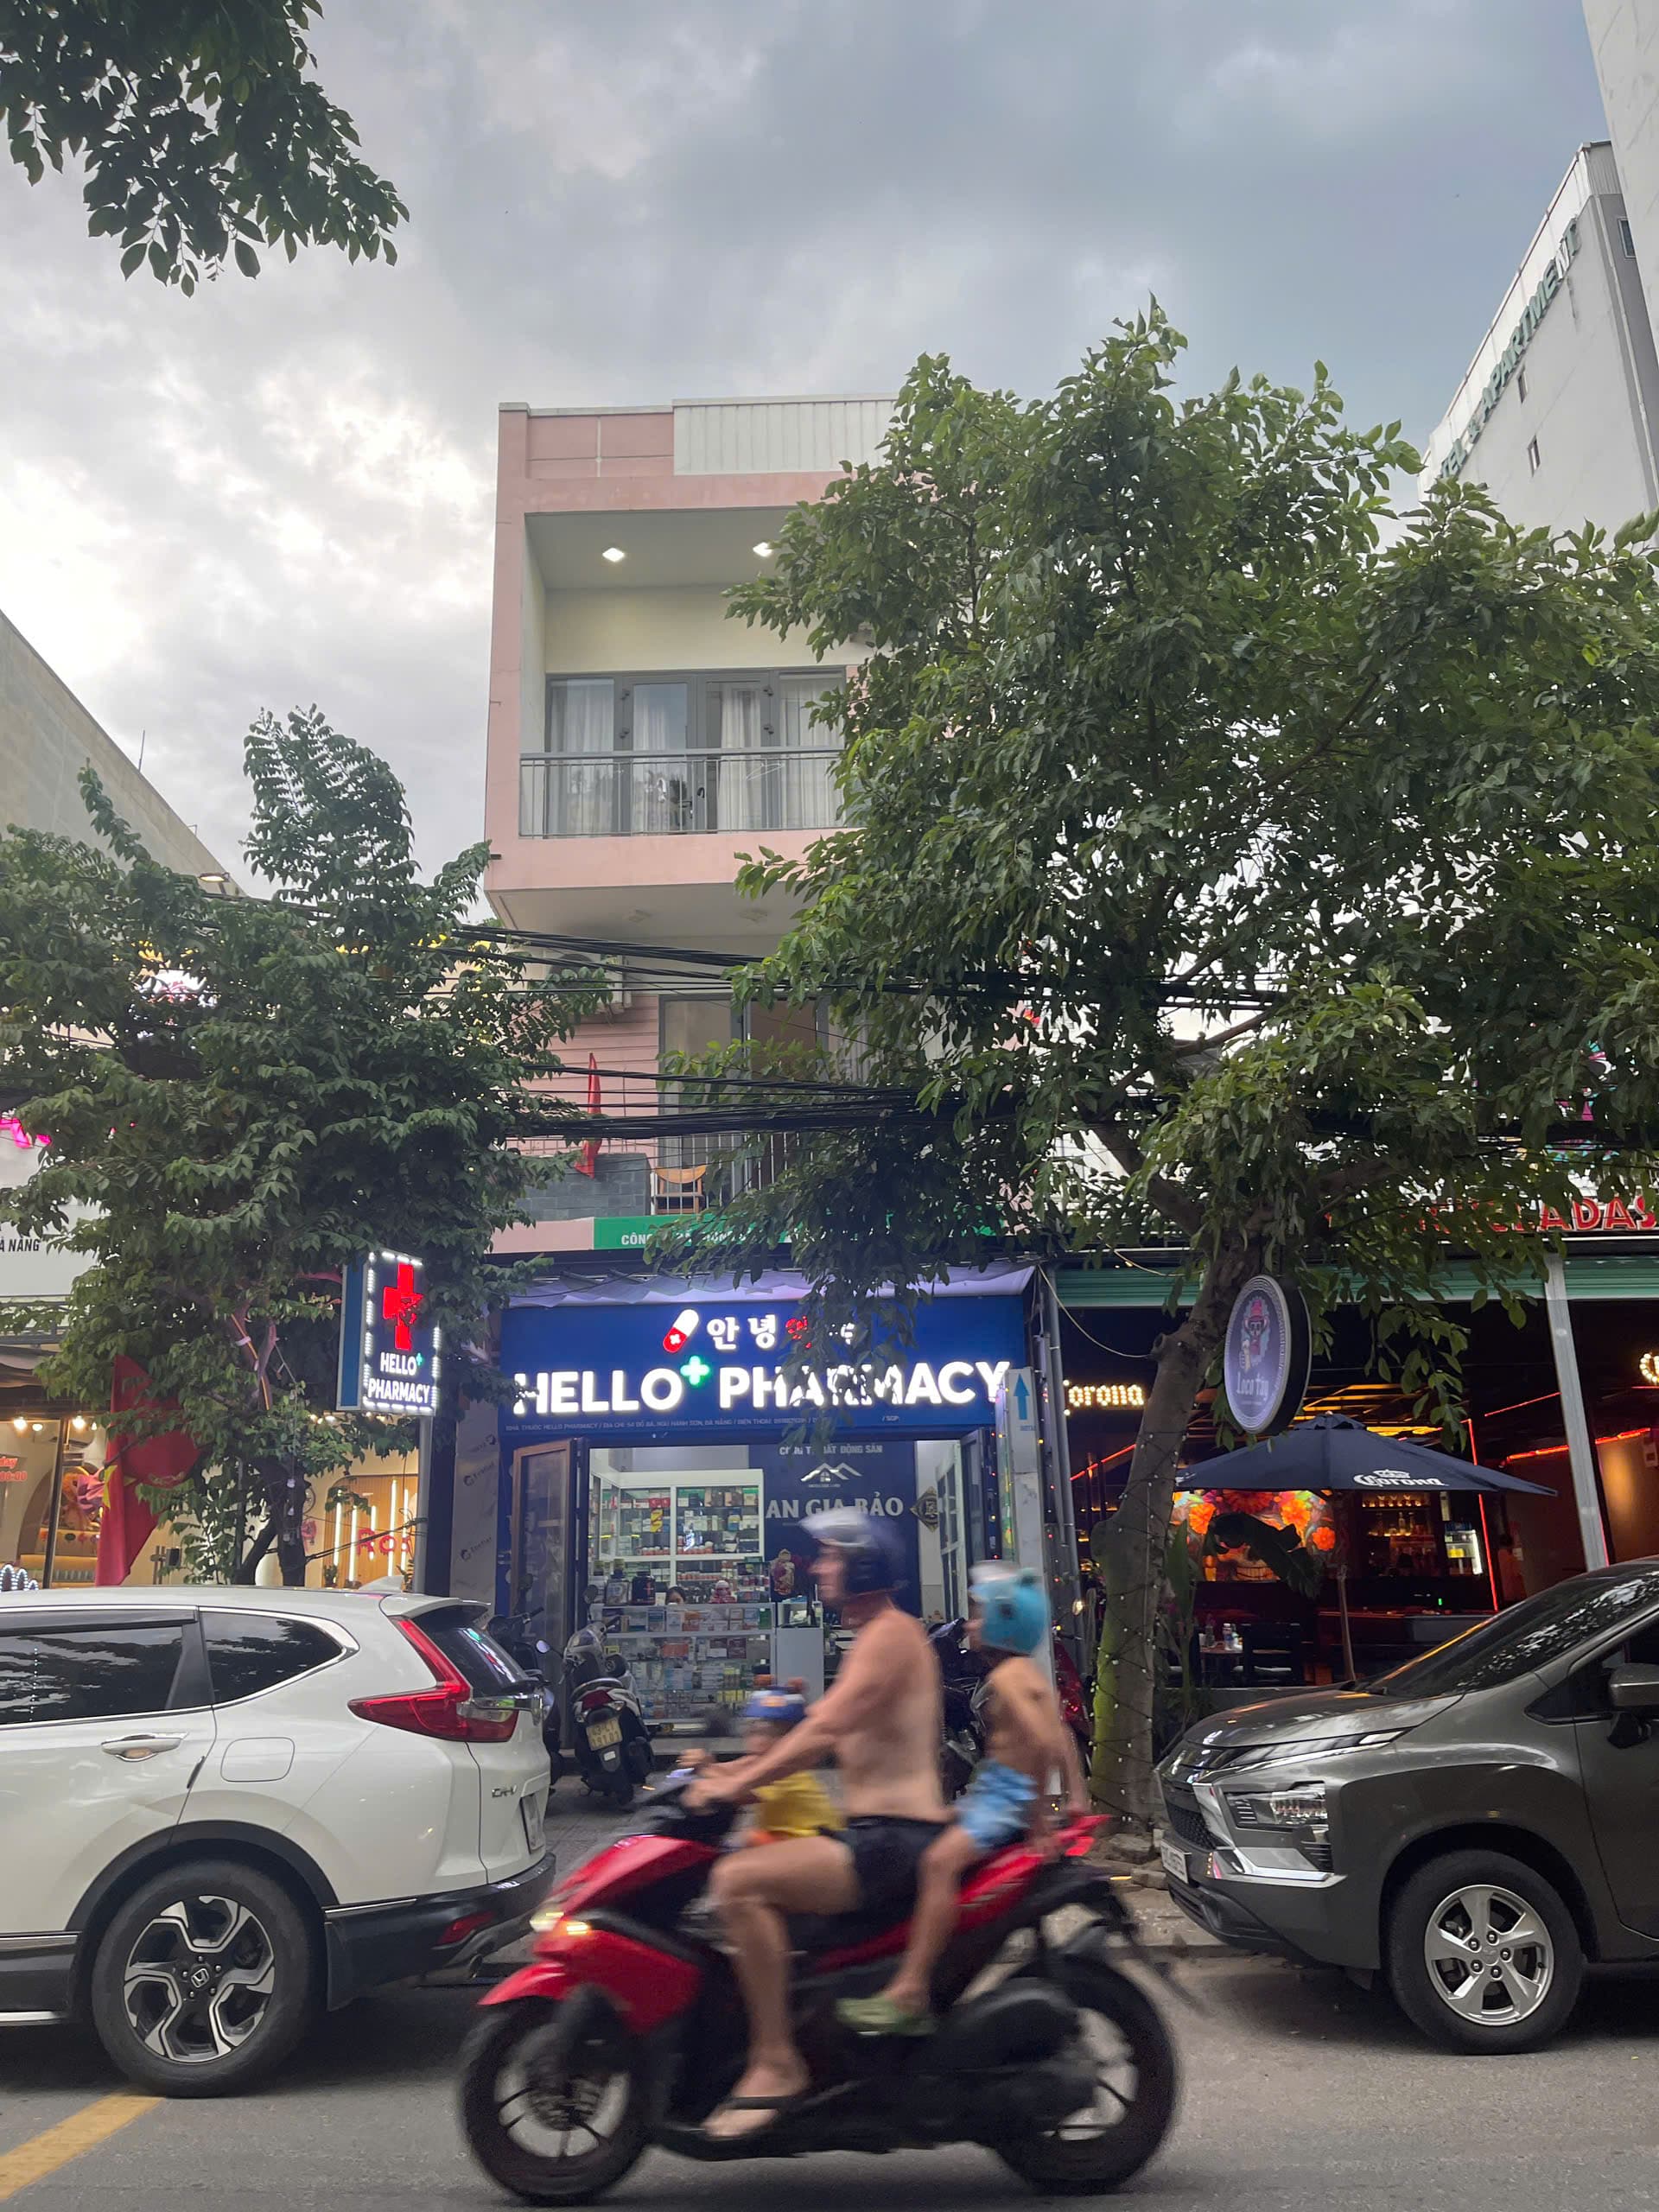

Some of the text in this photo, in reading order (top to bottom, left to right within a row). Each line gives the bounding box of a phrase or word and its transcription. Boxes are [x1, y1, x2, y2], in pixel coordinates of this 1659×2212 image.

[1482, 216, 1579, 423] APARTMENT
[706, 1313, 777, 1351] 안녕
[380, 1351, 417, 1376] HELLO
[368, 1377, 430, 1404] PHARMACY
[513, 1368, 683, 1414] HELLO
[1063, 1380, 1145, 1415] orona
[1353, 1473, 1450, 1487] Corona
[766, 1499, 799, 1518] AN
